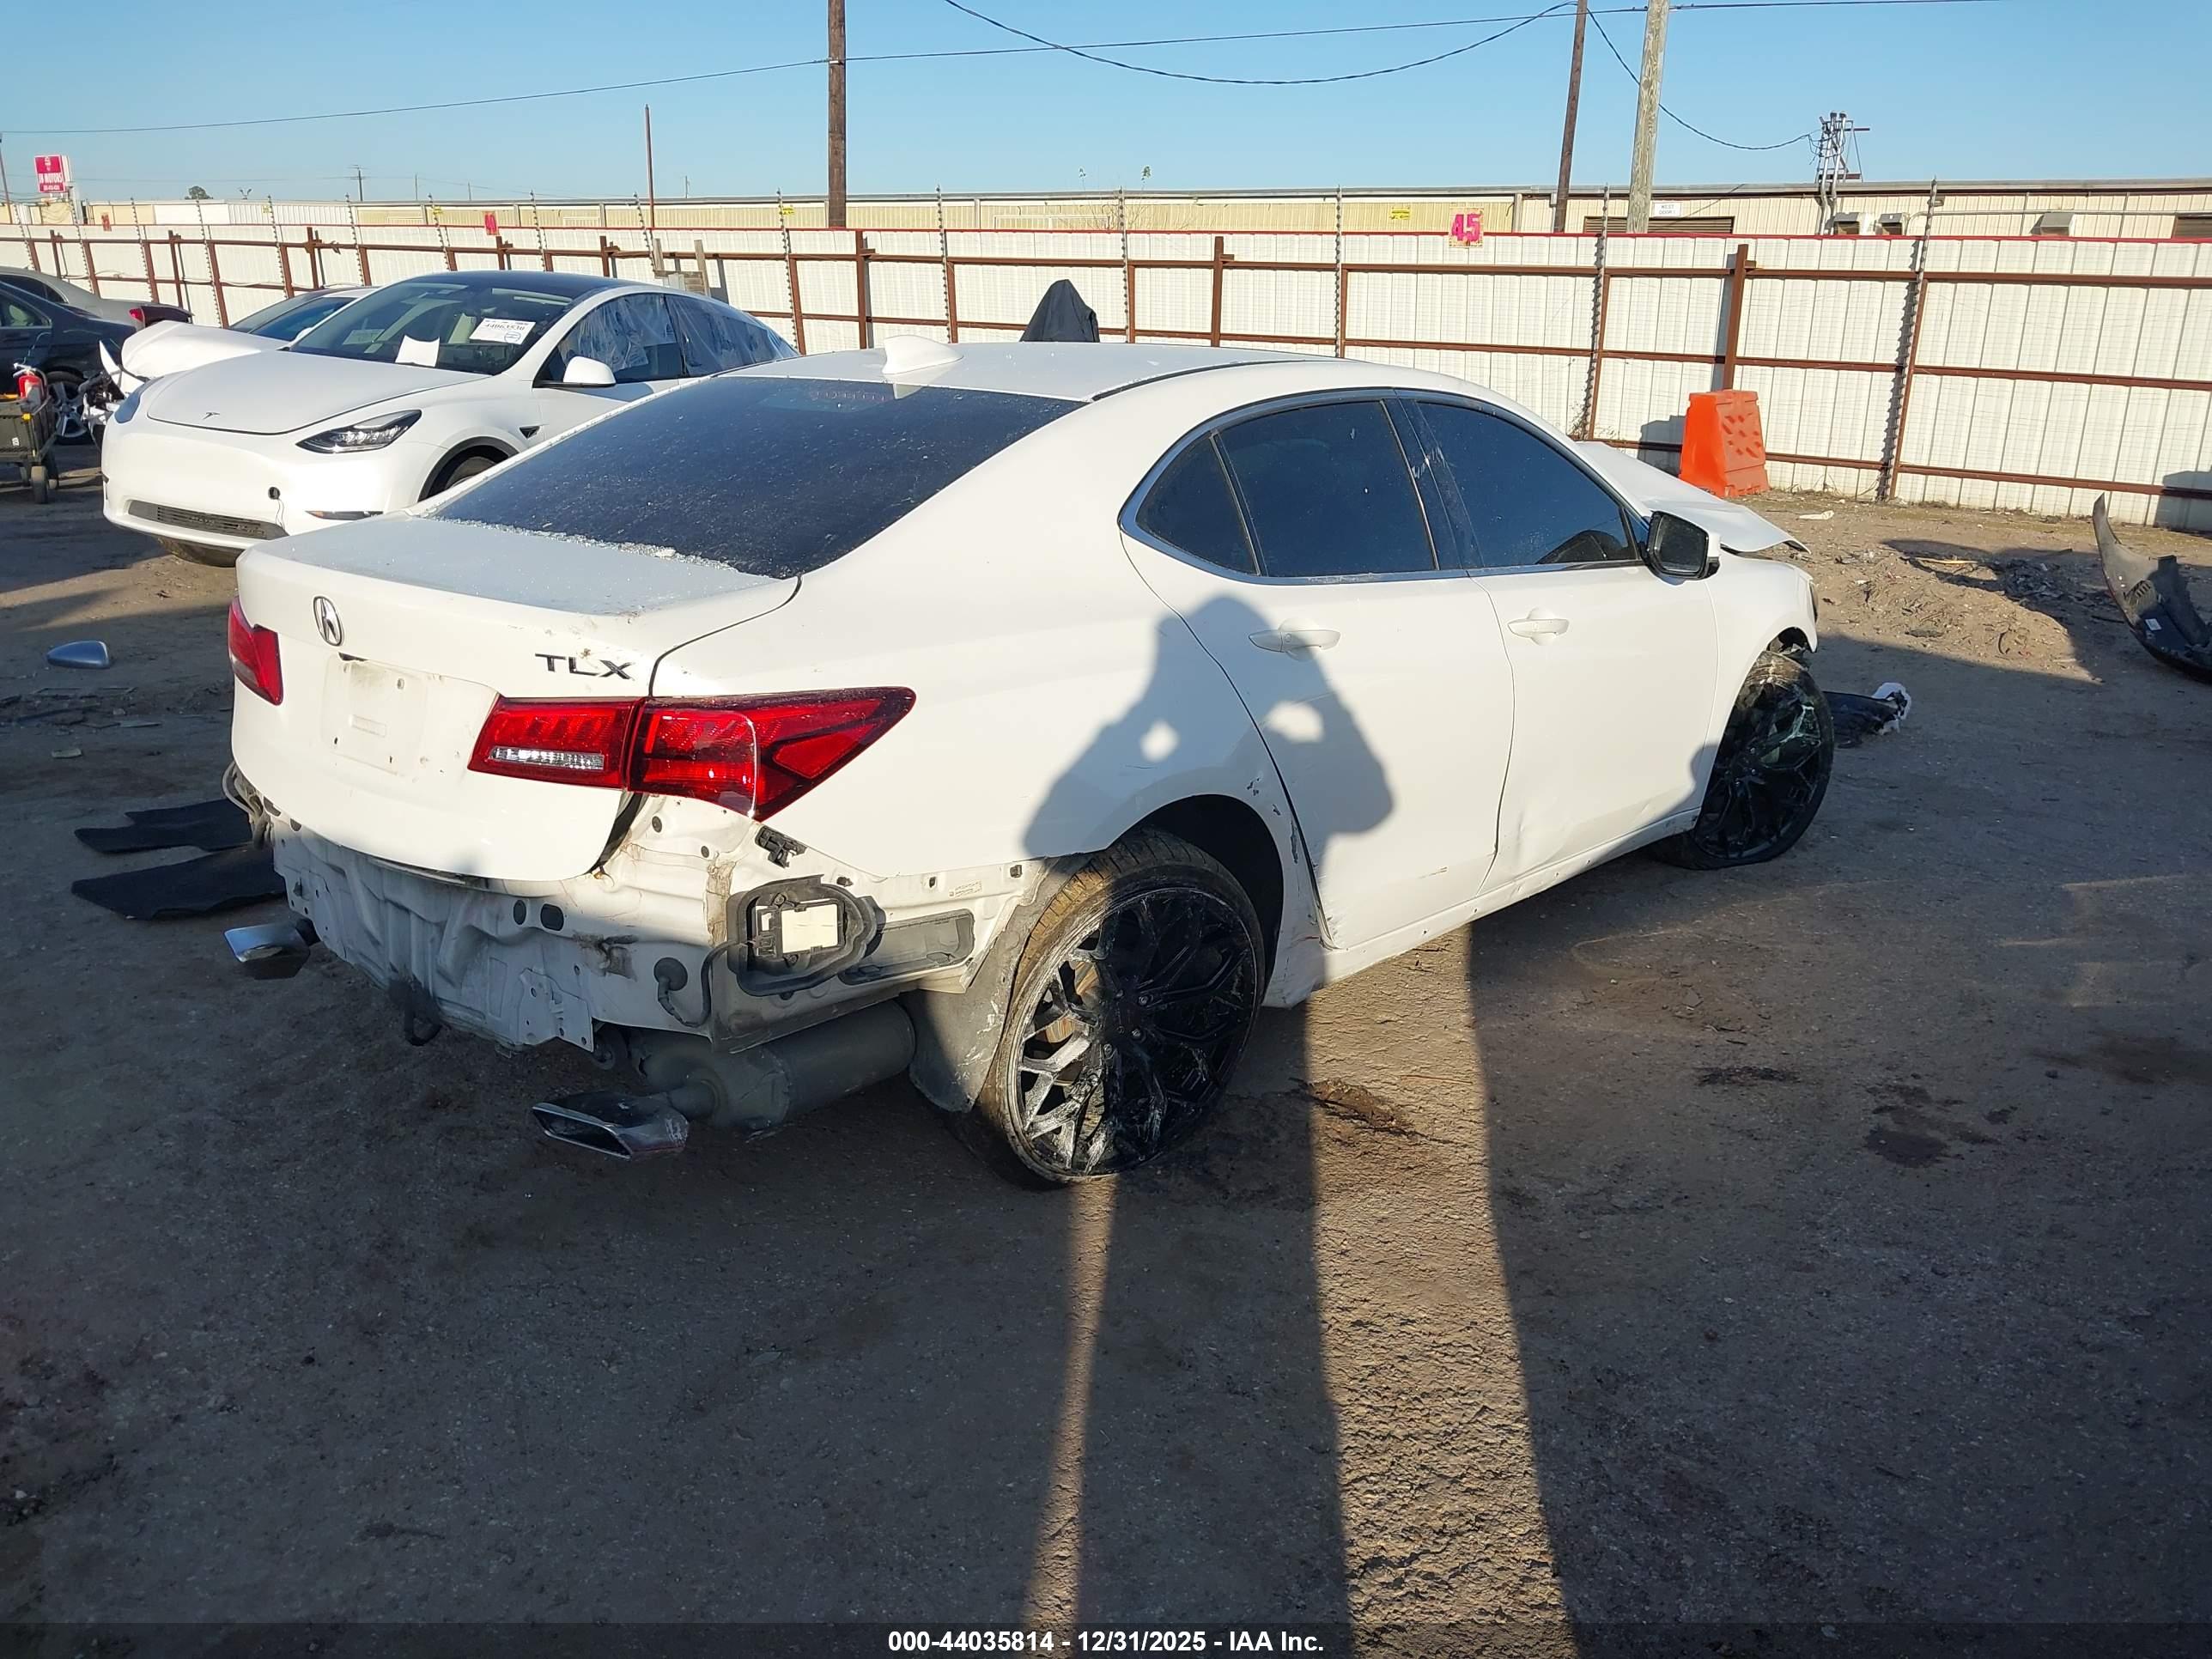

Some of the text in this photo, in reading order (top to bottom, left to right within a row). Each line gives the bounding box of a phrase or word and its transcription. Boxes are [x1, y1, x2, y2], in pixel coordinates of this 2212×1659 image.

[45, 172, 64, 184] MOTORS
[1452, 214, 1481, 241] 45
[535, 653, 635, 681] TLX
